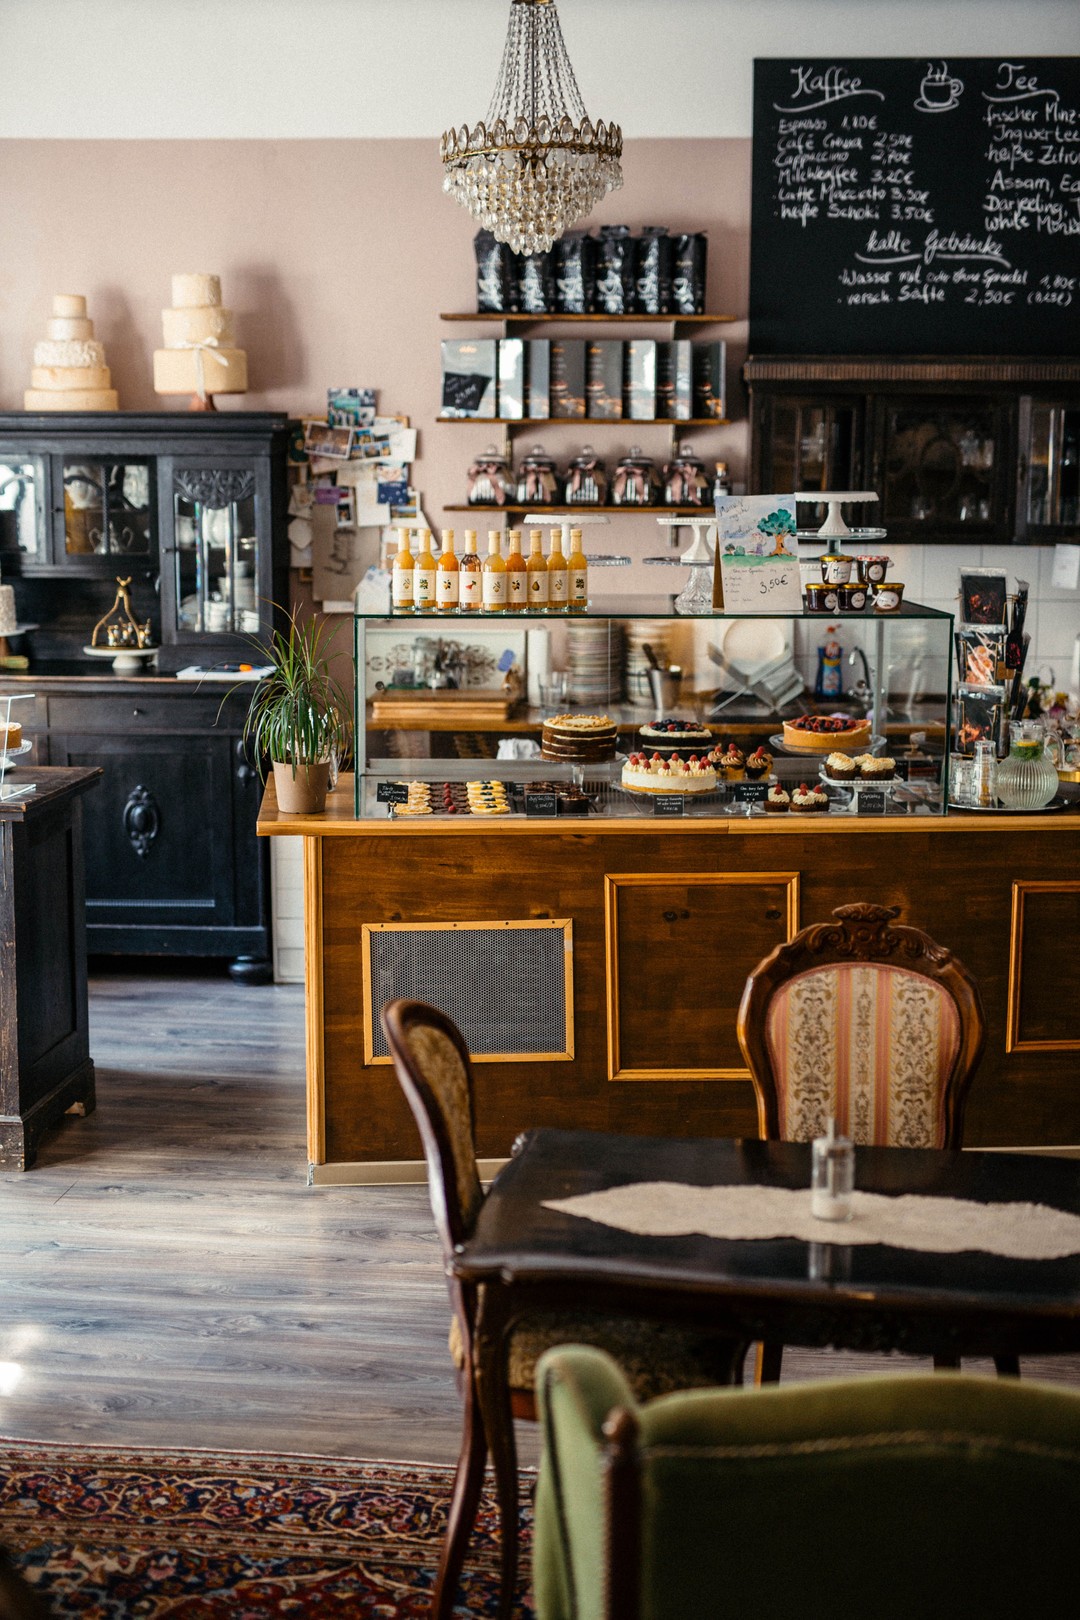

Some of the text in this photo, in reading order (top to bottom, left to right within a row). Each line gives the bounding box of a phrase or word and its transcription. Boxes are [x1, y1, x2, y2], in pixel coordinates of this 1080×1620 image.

[790, 65, 862, 101] Kaffee
[995, 62, 1038, 91] Tee
[986, 103, 1039, 127] frischer
[778, 118, 827, 136] Espresso
[777, 132, 815, 155] Café
[822, 132, 863, 150] Crema
[1037, 144, 1080, 166] Zitro
[775, 149, 850, 171] Cappuccino
[778, 165, 858, 188] Milchkaffee
[778, 186, 817, 202] Latte
[780, 202, 935, 228] heiße Schoki 3,50€
[984, 209, 1031, 231] white
[865, 229, 912, 254] kalte
[841, 268, 893, 287] Wasser
[898, 264, 923, 284] mit
[982, 268, 1029, 289] Sprudel
[759, 574, 789, 594] 3,50€
